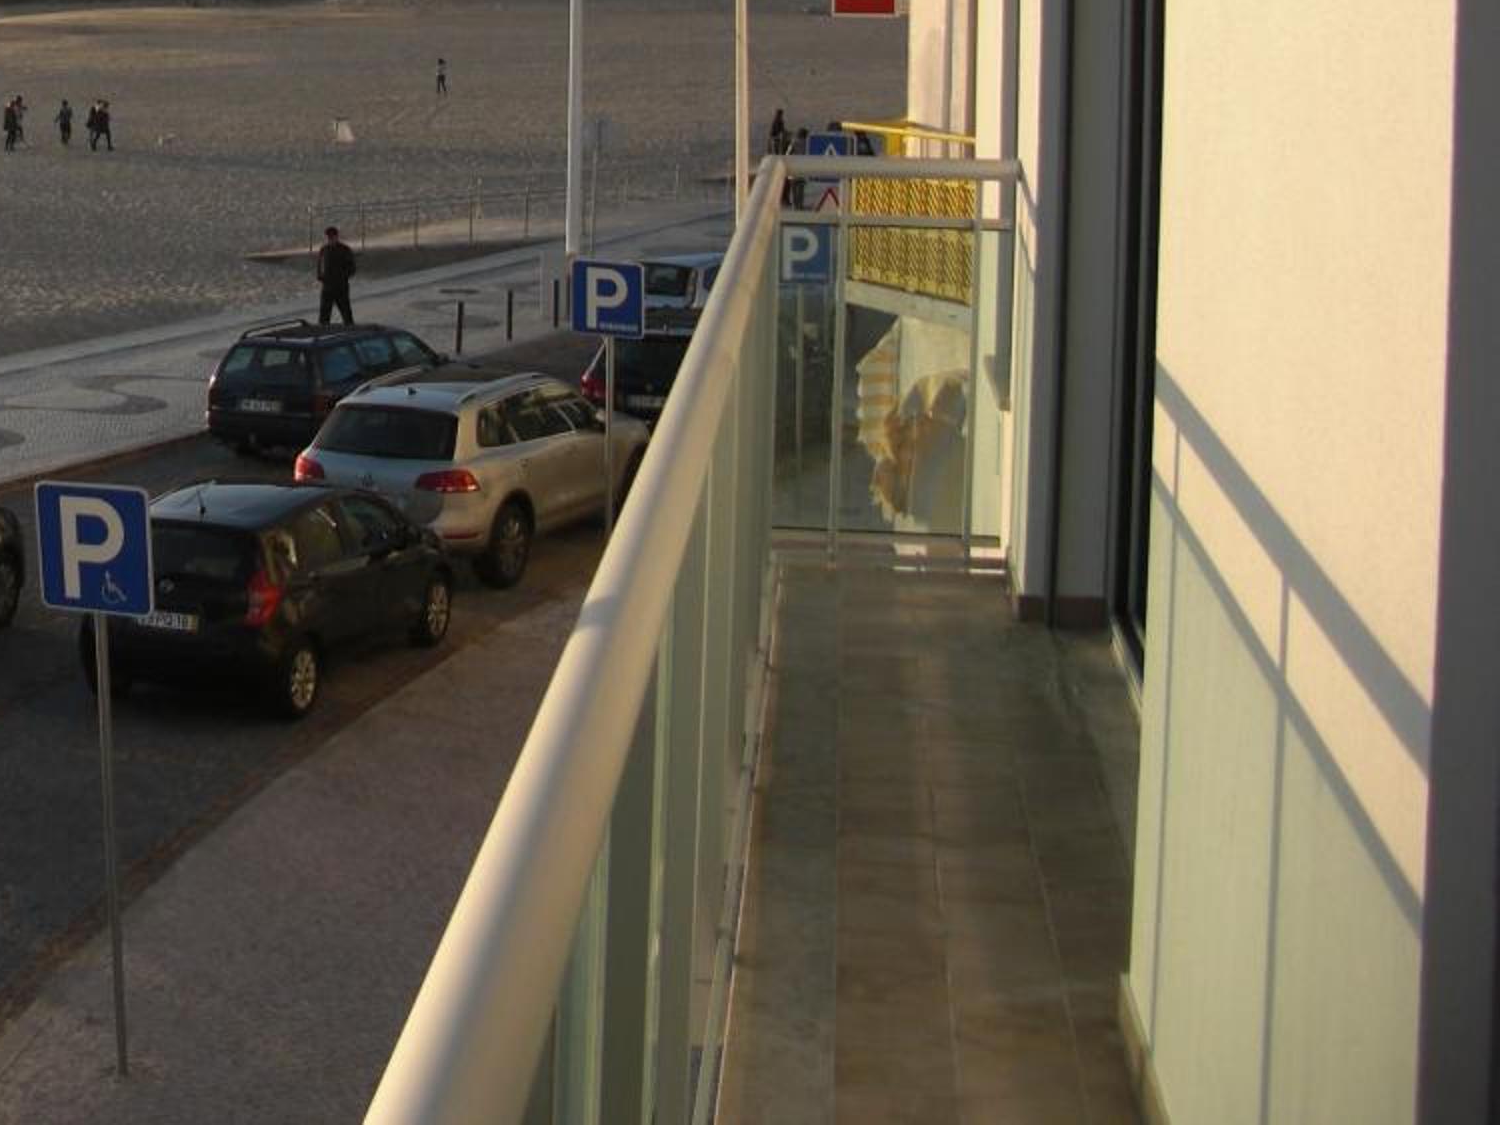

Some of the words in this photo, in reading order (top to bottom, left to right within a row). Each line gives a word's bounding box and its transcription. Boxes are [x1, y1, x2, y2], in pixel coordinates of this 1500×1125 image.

[783, 227, 818, 280] P
[586, 266, 628, 328] P
[59, 495, 124, 599] P
